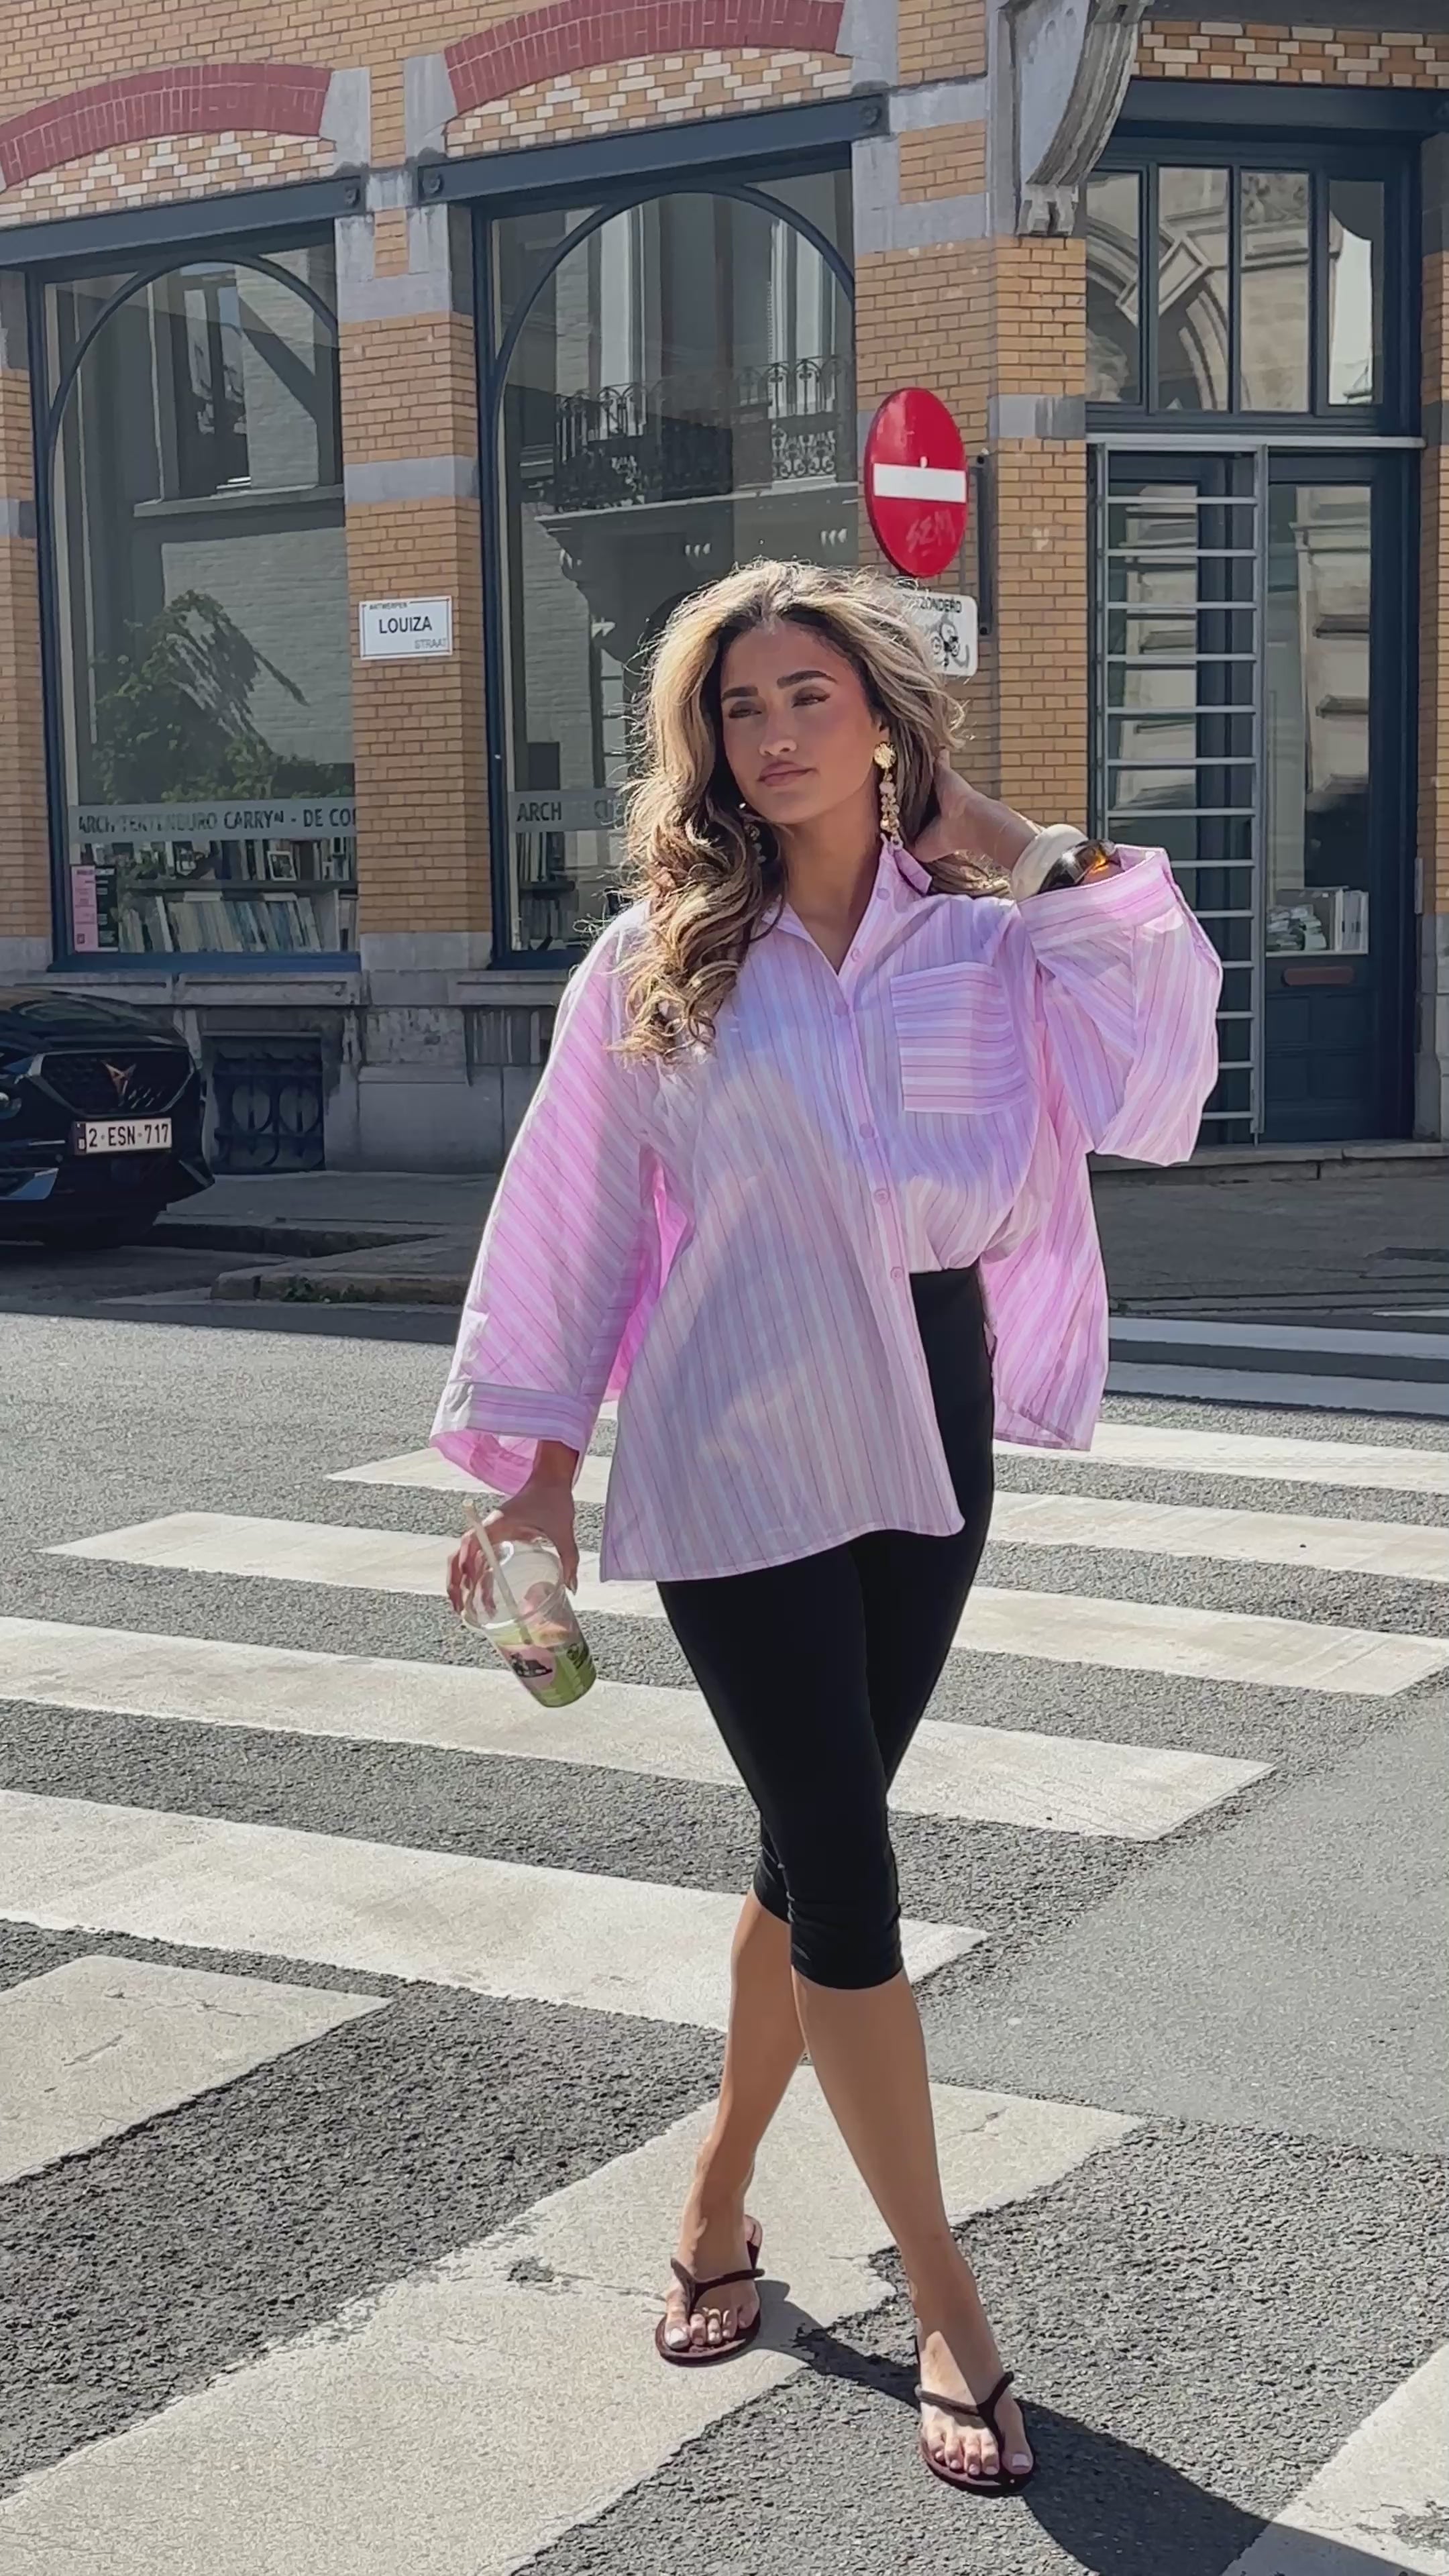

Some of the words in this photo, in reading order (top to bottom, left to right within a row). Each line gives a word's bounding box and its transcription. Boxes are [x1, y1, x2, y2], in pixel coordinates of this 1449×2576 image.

[378, 616, 433, 634] LOUIZA
[415, 638, 447, 649] STRAAT
[303, 808, 323, 827] DE
